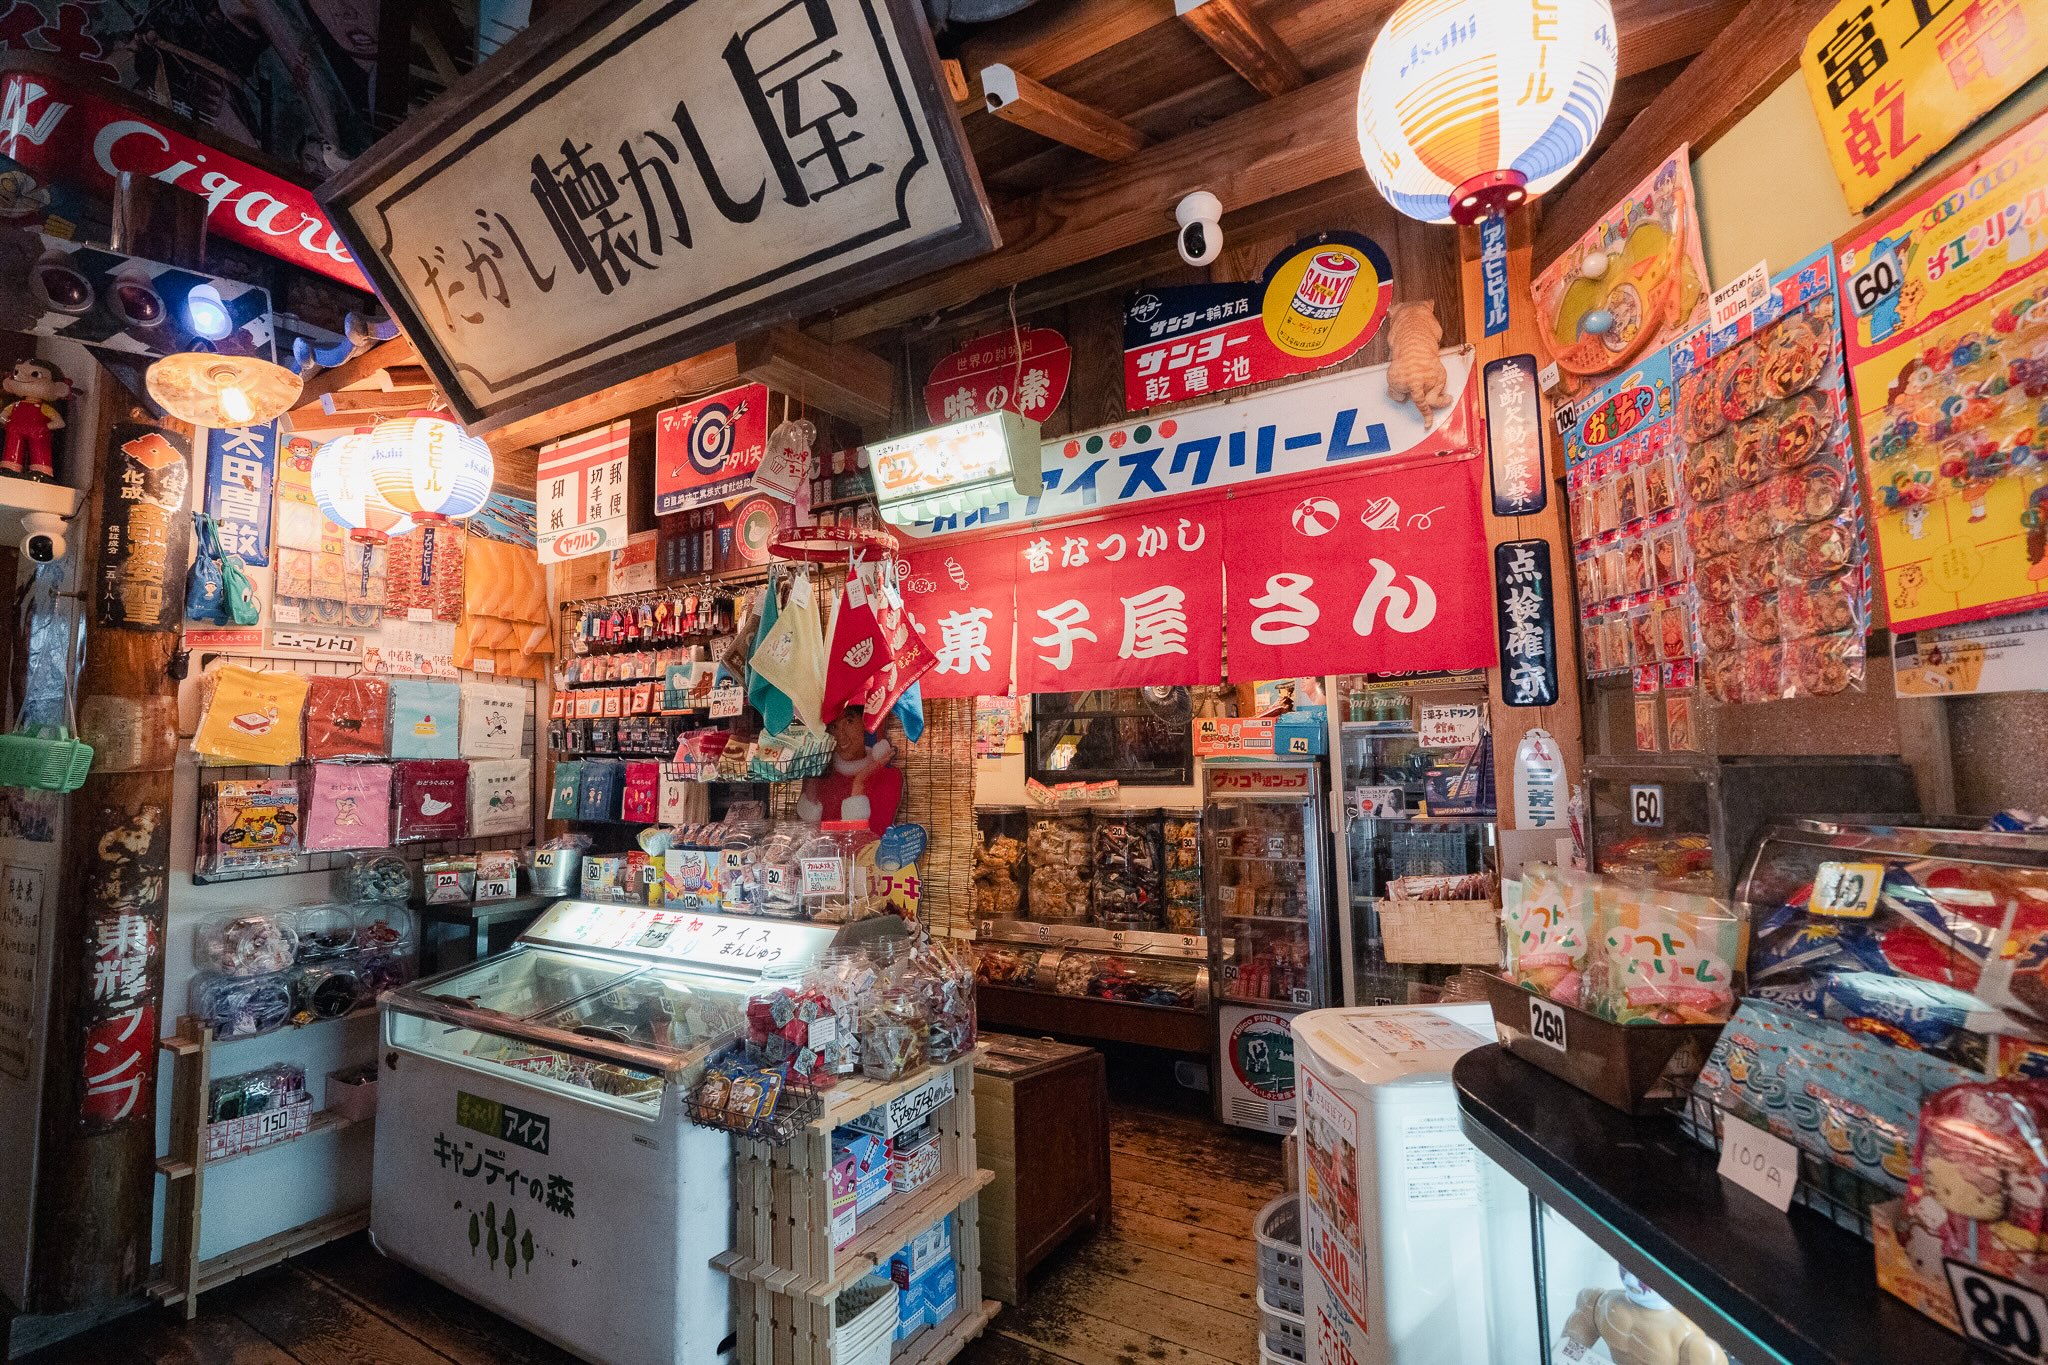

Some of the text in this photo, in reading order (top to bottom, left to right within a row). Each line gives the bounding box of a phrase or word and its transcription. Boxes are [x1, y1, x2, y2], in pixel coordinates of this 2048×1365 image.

[1300, 268, 1355, 306] SANYO
[1483, 224, 1507, 329] アサヒビール
[1137, 332, 1251, 377] サンヨー
[944, 368, 1050, 421] 味の素
[1146, 357, 1251, 402] 乾電池
[1588, 388, 1653, 444] おもちゃ
[218, 427, 266, 558] 太田胃散
[550, 478, 565, 530] 印紙
[589, 466, 604, 520] 切手類
[608, 460, 623, 515] 郵便
[563, 532, 597, 553] ヤクルト
[1024, 517, 1207, 574] 昔なつかし
[908, 557, 1437, 675] 菓子屋さん
[278, 635, 353, 652] ニューレトロ
[711, 925, 771, 942] アイス
[720, 942, 782, 962] まんじゅう
[1607, 932, 1685, 958] ソフト
[1628, 958, 1725, 983] クリーム
[1253, 1015, 1277, 1023] FINE
[262, 1110, 289, 1134] 150
[504, 1109, 547, 1151] アイス
[433, 1131, 576, 1220] キャンディーの森
[1963, 1275, 2042, 1357] 80
